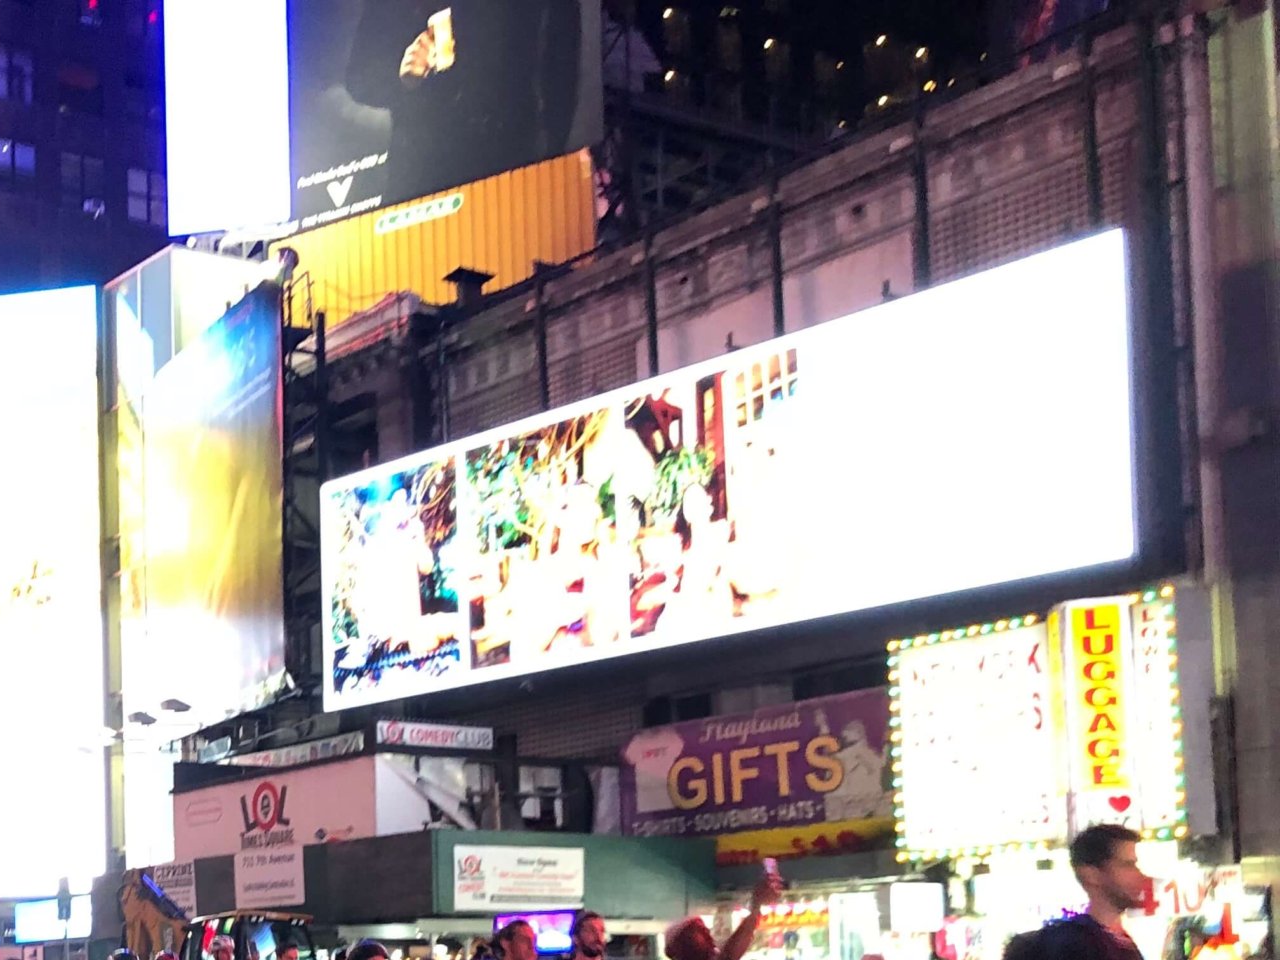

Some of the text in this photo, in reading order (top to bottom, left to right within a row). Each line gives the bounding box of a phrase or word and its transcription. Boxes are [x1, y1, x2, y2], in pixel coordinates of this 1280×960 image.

[1082, 608, 1120, 785] LUGGAGE
[667, 735, 845, 810] GIFTS
[239, 781, 291, 834] LOL
[694, 805, 768, 832] SOUVENIRS
[777, 800, 815, 822] HATS
[240, 828, 295, 850] TIMES SQUARE
[268, 853, 296, 864] Avenue
